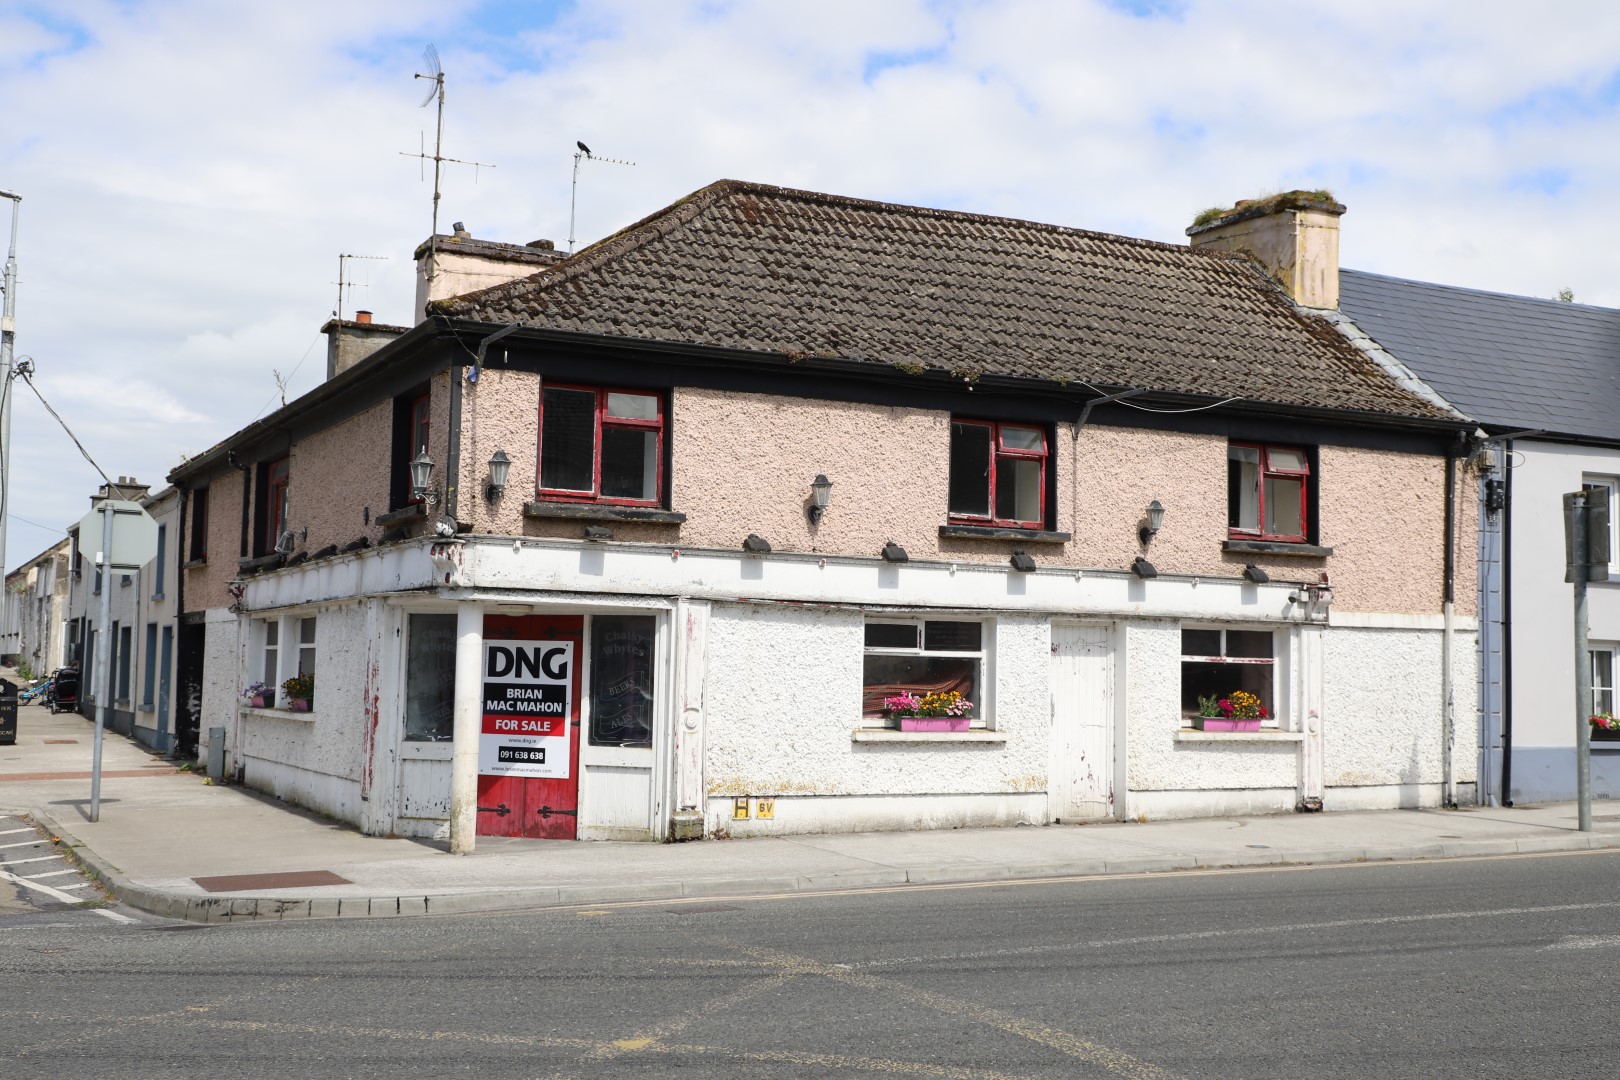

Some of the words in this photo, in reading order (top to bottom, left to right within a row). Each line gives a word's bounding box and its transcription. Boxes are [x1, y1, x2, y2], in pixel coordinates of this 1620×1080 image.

[487, 646, 568, 680] DNG
[506, 688, 543, 699] BRIAN
[486, 700, 514, 711] MAC
[516, 701, 562, 713] MAHON
[495, 719, 518, 730] FOR
[521, 720, 551, 732] SALE
[500, 750, 513, 759] 091
[514, 751, 528, 760] 638
[530, 752, 543, 760] 638
[491, 766, 552, 774] www.brianmacmahon.com
[735, 797, 749, 818] H
